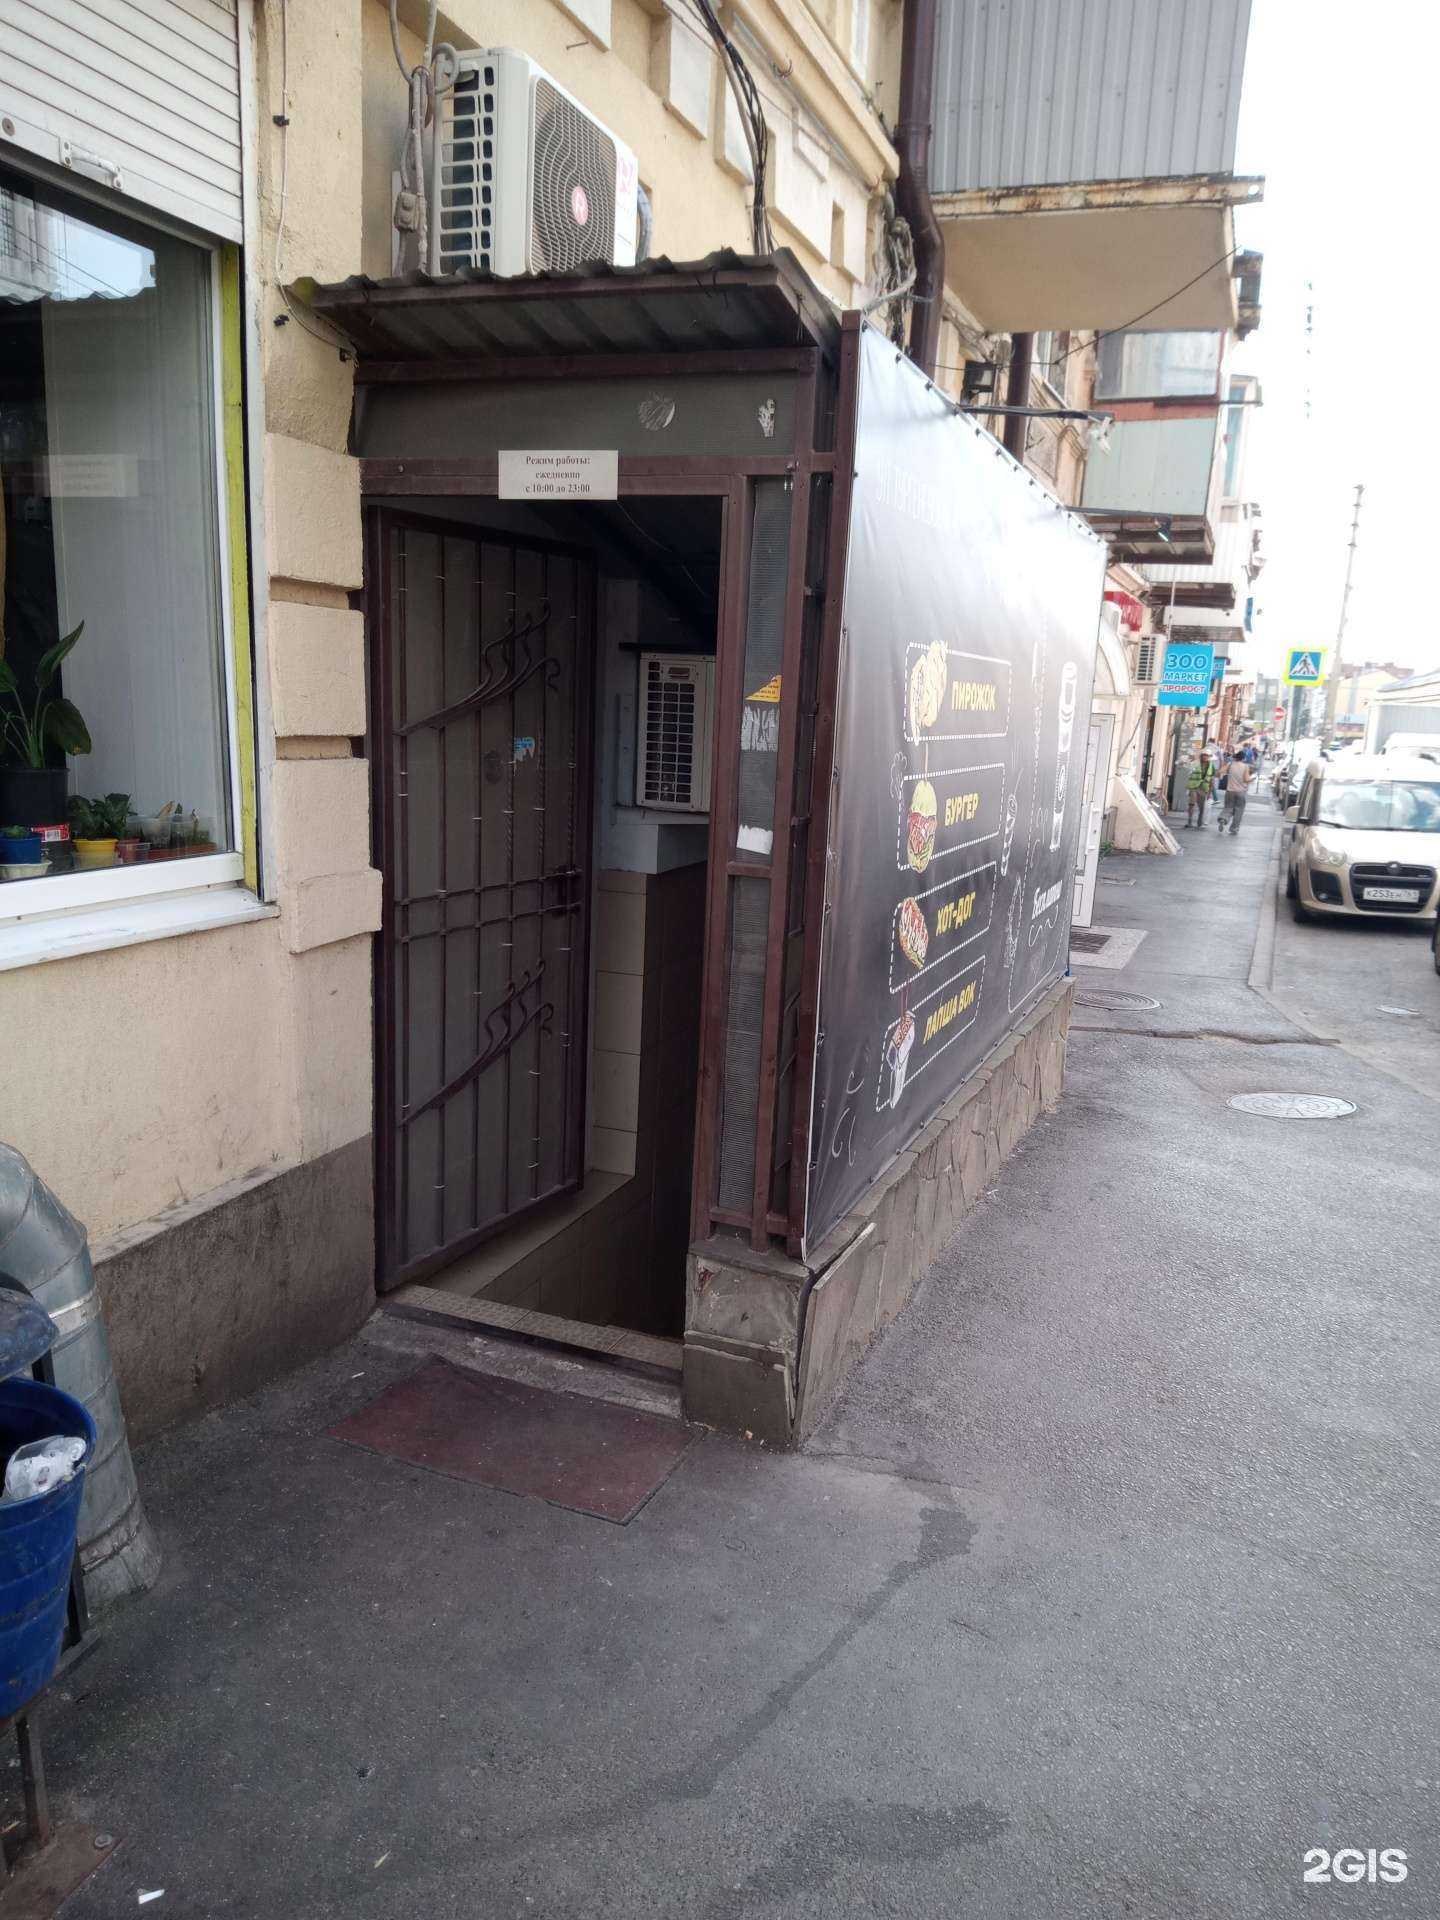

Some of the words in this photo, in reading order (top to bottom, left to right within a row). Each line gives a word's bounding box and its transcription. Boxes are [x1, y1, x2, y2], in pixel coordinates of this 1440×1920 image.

[526, 455, 554, 465] Режим
[556, 455, 591, 467] работы:
[532, 484, 554, 493] 10:00
[555, 486, 566, 494] до
[568, 484, 590, 493] 23:00
[1164, 672, 1208, 681] МАРКЕТ
[952, 681, 996, 711] ПИРОЖОК
[944, 793, 979, 827] БУРГЕР
[936, 891, 976, 936] ХОТ-ДОГ
[923, 1003, 958, 1045] ЛАПША
[957, 980, 977, 1019] ВОК
